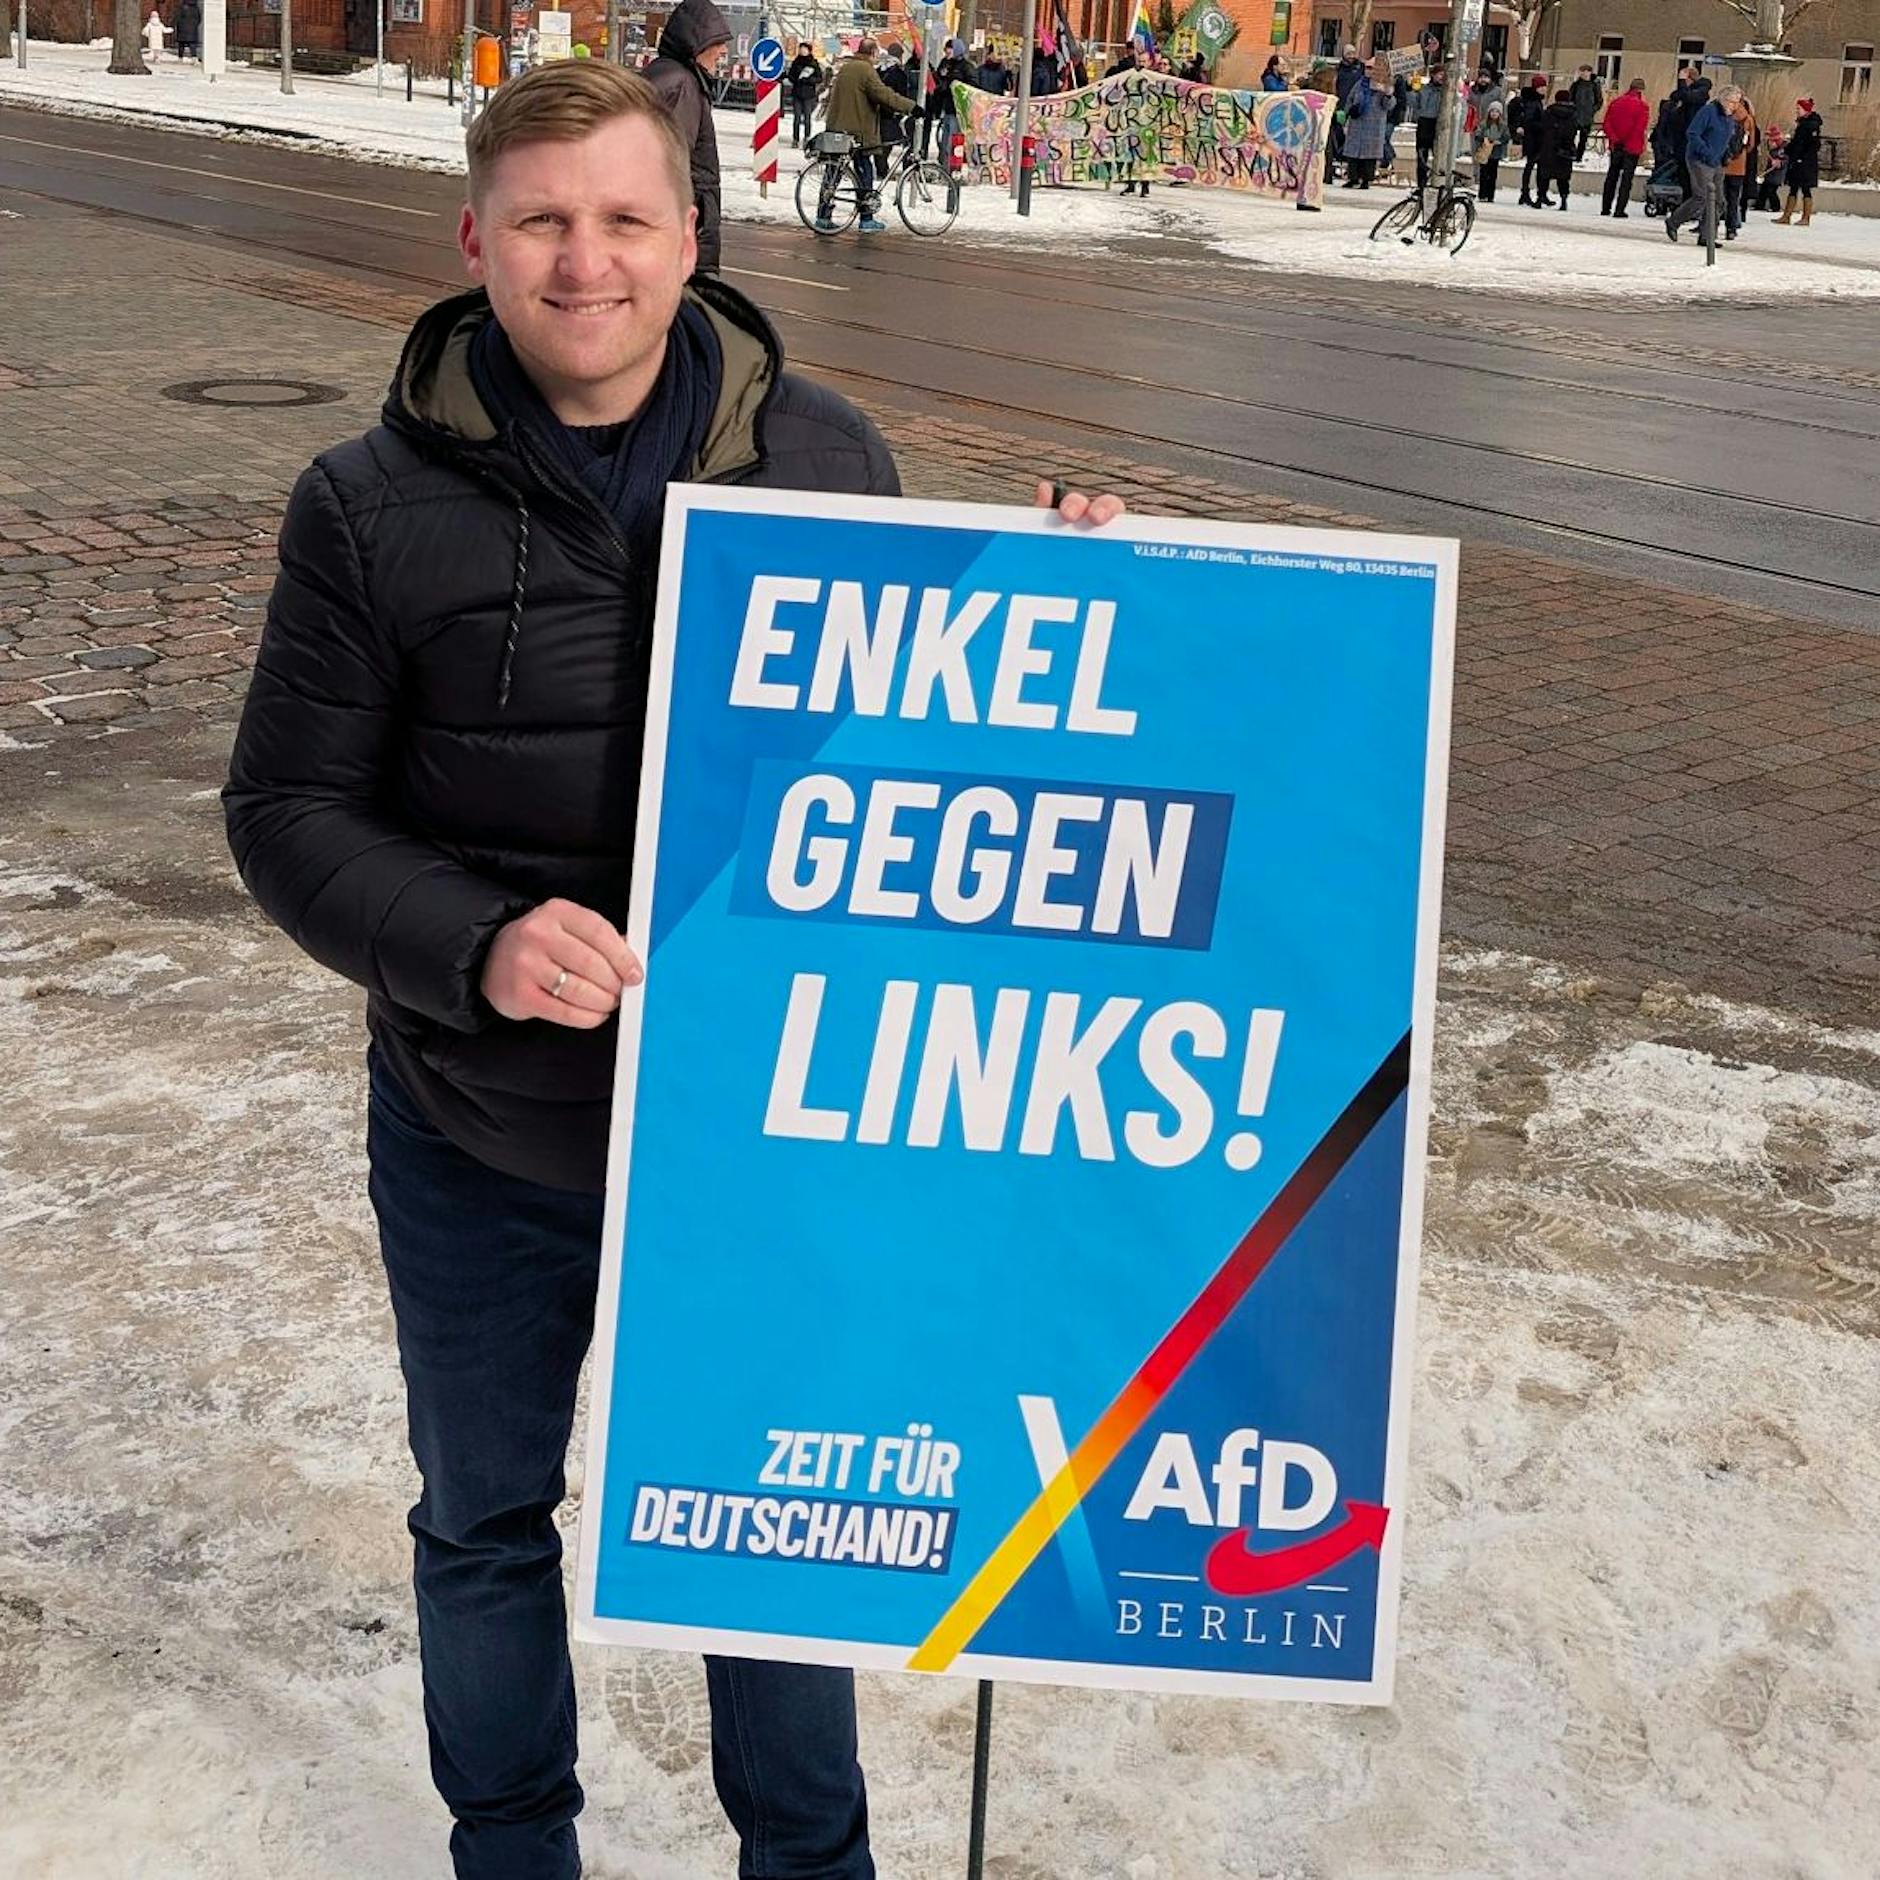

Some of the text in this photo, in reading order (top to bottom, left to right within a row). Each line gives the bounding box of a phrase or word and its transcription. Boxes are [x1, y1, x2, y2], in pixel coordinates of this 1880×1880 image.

[1186, 548, 1208, 561] AfD
[1319, 559, 1345, 574] Weg
[1399, 565, 1435, 579] Berlin
[728, 574, 1138, 736] ENKEL
[766, 774, 1196, 938] GEGEN
[762, 972, 1286, 1172] LINKS!
[758, 1422, 961, 1498] ZEIT FÜR
[1123, 1428, 1338, 1532] AfD
[629, 1486, 950, 1569] DEUTSCHAND!
[1116, 1599, 1347, 1651] BERLIN
